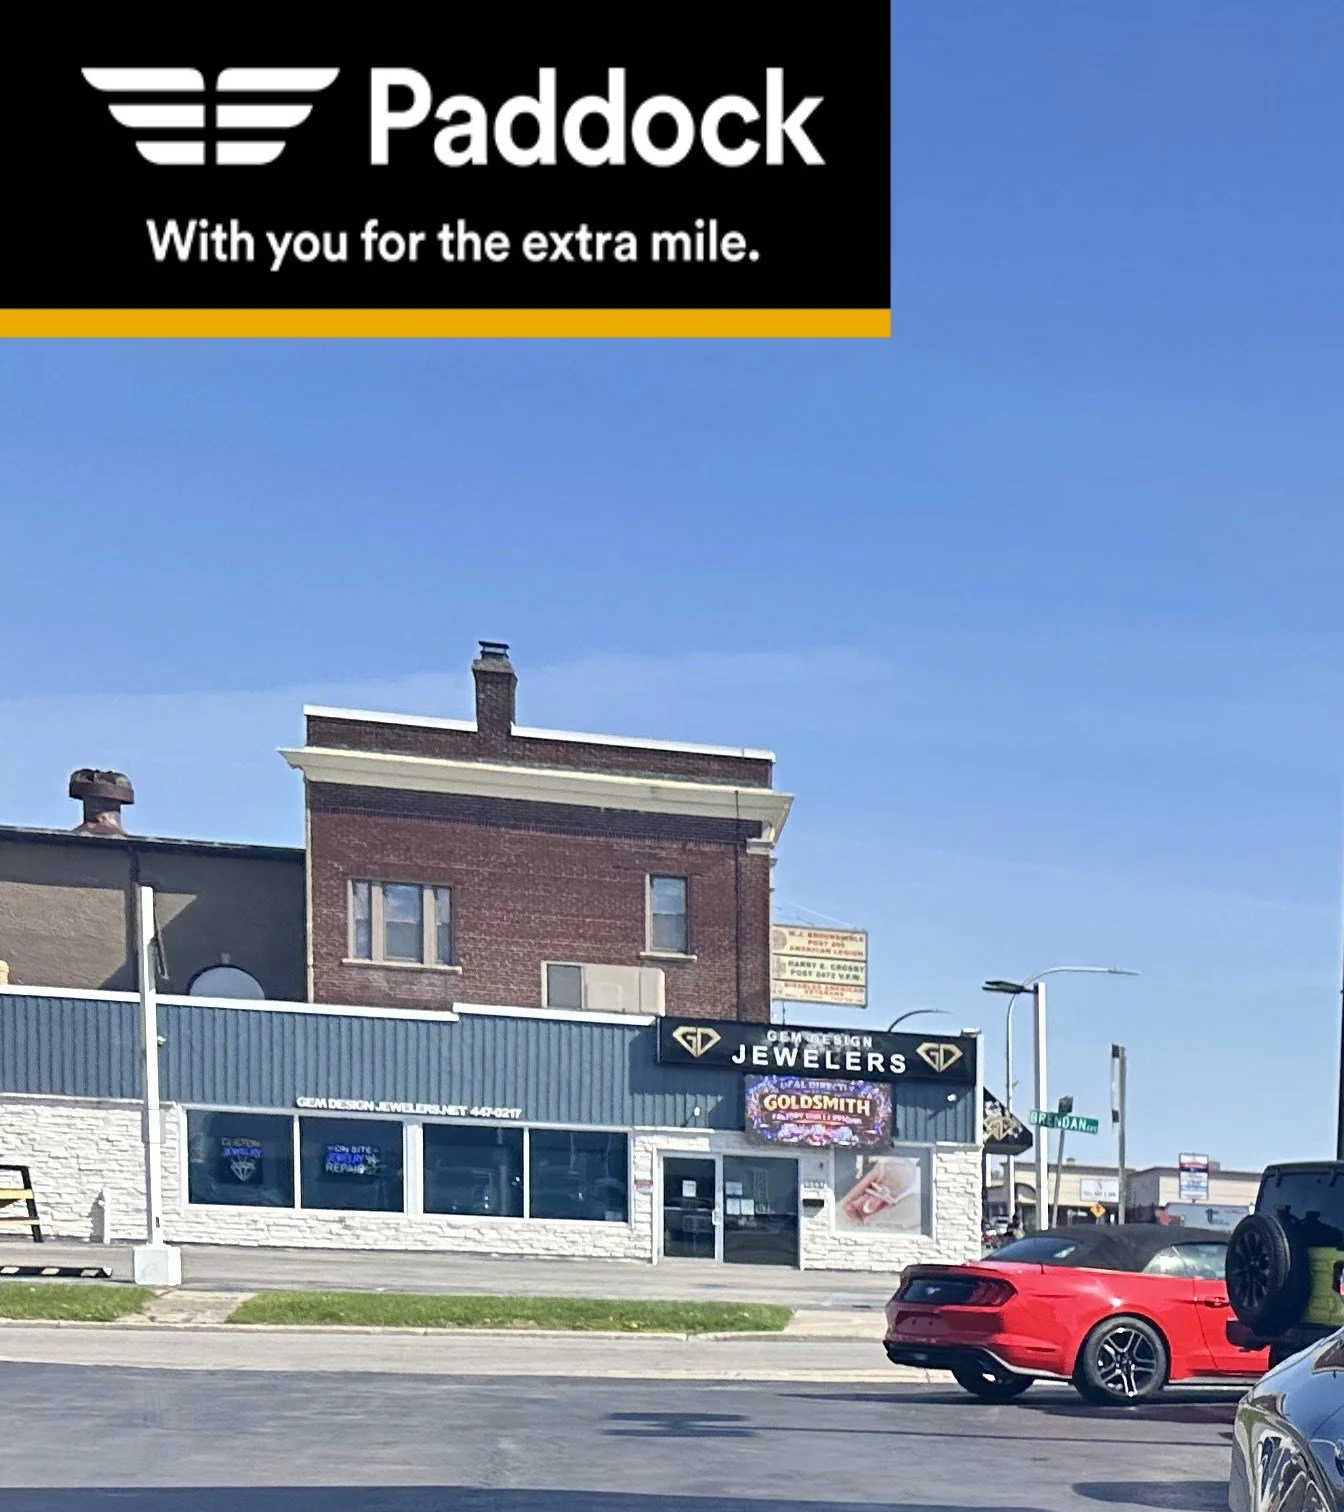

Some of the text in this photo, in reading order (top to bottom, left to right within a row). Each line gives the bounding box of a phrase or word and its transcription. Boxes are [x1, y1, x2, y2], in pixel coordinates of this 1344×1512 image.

[766, 1029, 873, 1048] GEM DESIGN
[731, 1043, 906, 1074] JEWELERS
[296, 1096, 329, 1109] GEM
[328, 1098, 375, 1111] DESIGN
[375, 1100, 468, 1117] JEWELERS.NET
[763, 1094, 871, 1117] GOLDSMITH
[1030, 1111, 1087, 1131] BRENDAN
